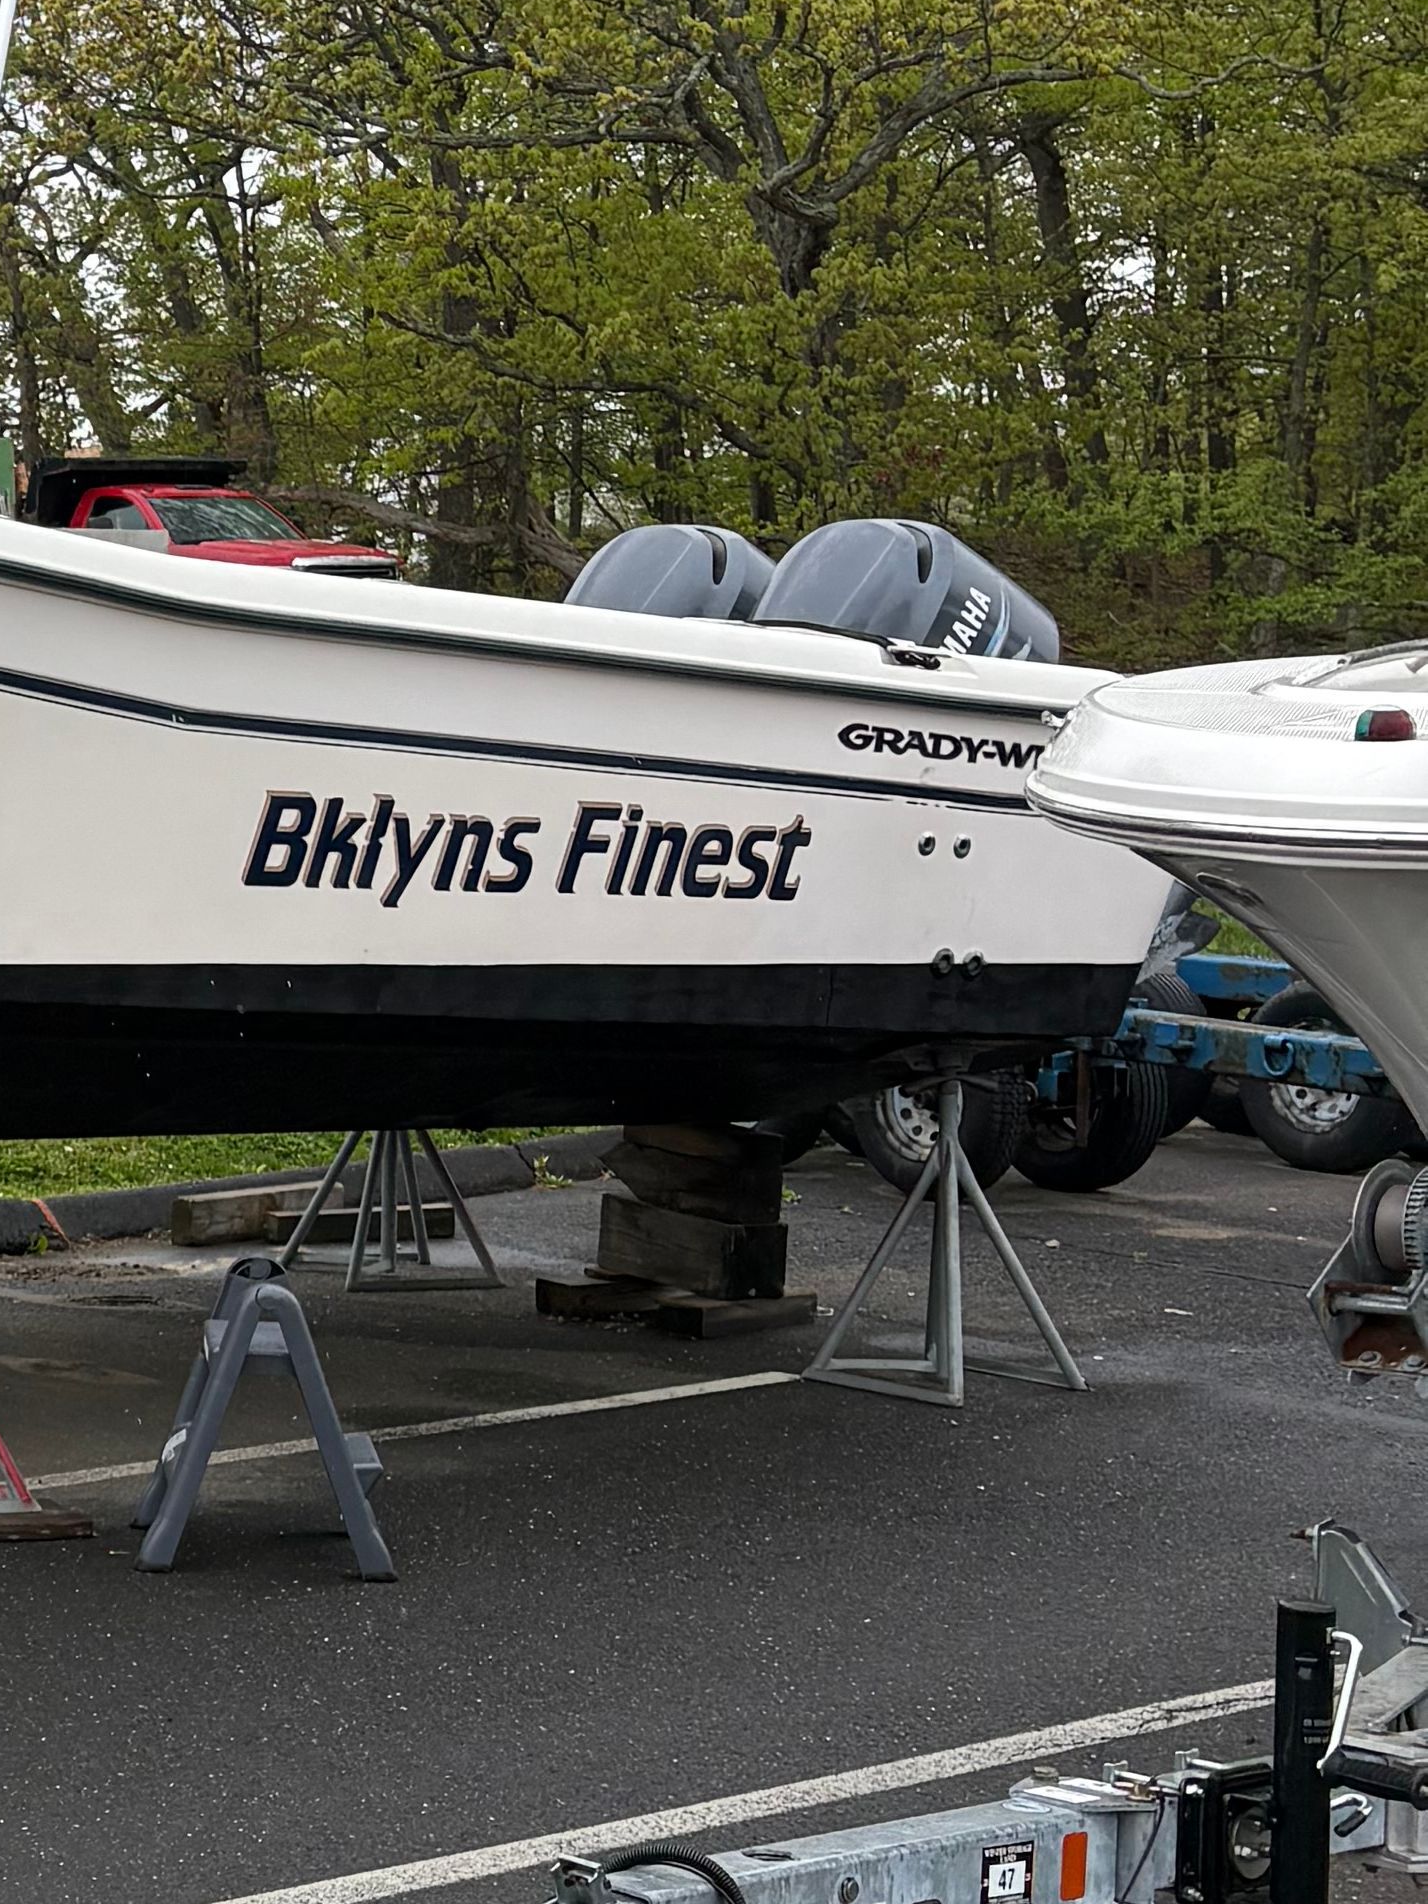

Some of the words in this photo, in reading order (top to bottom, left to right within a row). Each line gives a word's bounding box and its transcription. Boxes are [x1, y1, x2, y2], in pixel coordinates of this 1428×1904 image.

[943, 586, 992, 655] MAHA
[837, 722, 1046, 772] GRADY-W
[241, 789, 542, 908] Bklyns
[555, 799, 813, 902] Finest
[998, 1867, 1015, 1891] 47
